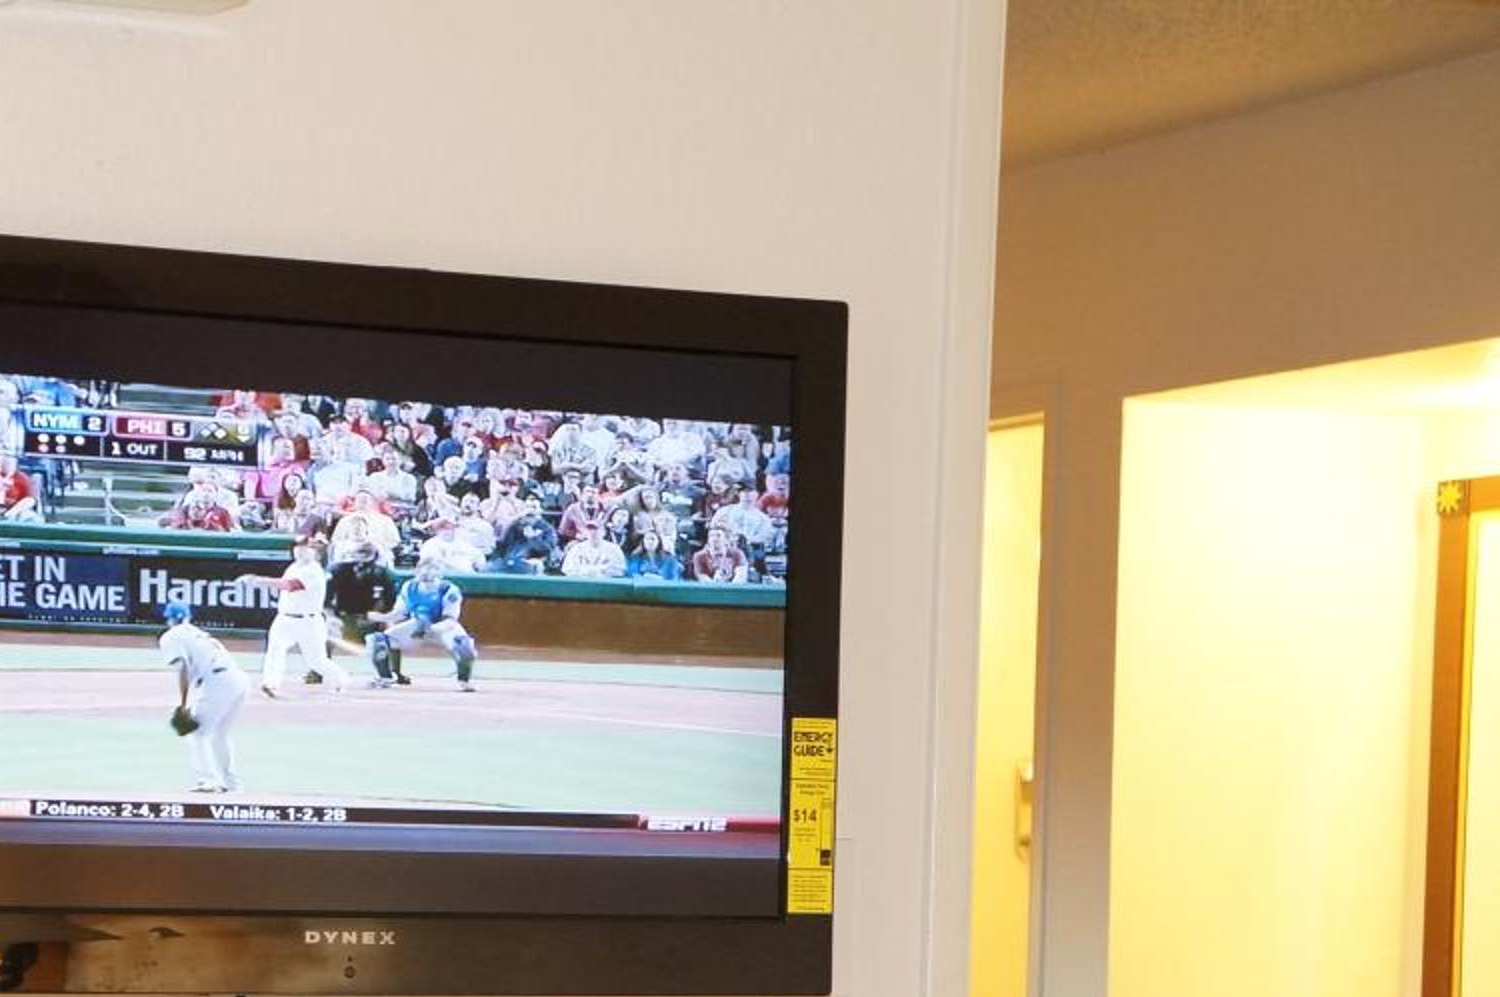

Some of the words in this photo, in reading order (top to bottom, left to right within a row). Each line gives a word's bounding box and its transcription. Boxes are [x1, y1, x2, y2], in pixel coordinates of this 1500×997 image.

[33, 414, 77, 429] NYM
[87, 417, 101, 432] 2
[127, 420, 166, 435] PHI
[172, 422, 186, 437] 5
[111, 443, 121, 455] 1
[127, 443, 158, 455] OUT
[34, 556, 66, 582] IN
[35, 583, 126, 611] GAME
[793, 745, 825, 757] GUIDE
[35, 801, 117, 817] Polanco:
[793, 808, 817, 823] $14
[305, 931, 396, 945] DYNEX
